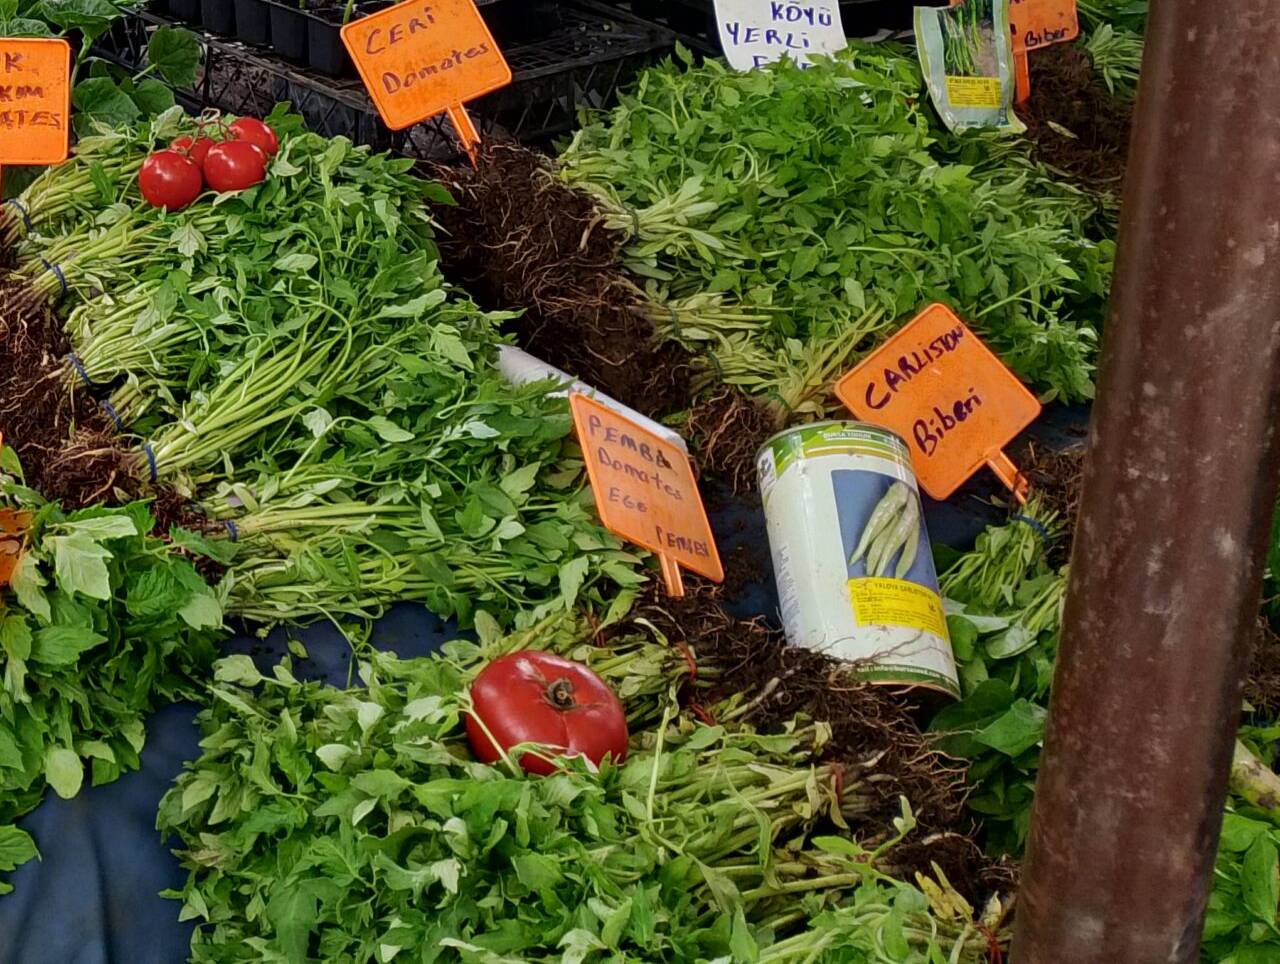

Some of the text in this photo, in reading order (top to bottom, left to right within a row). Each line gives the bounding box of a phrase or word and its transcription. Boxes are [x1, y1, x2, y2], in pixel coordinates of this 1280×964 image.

[1024, 27, 1070, 47] Biber
[381, 42, 490, 95] Domates
[597, 446, 683, 501] Domates
